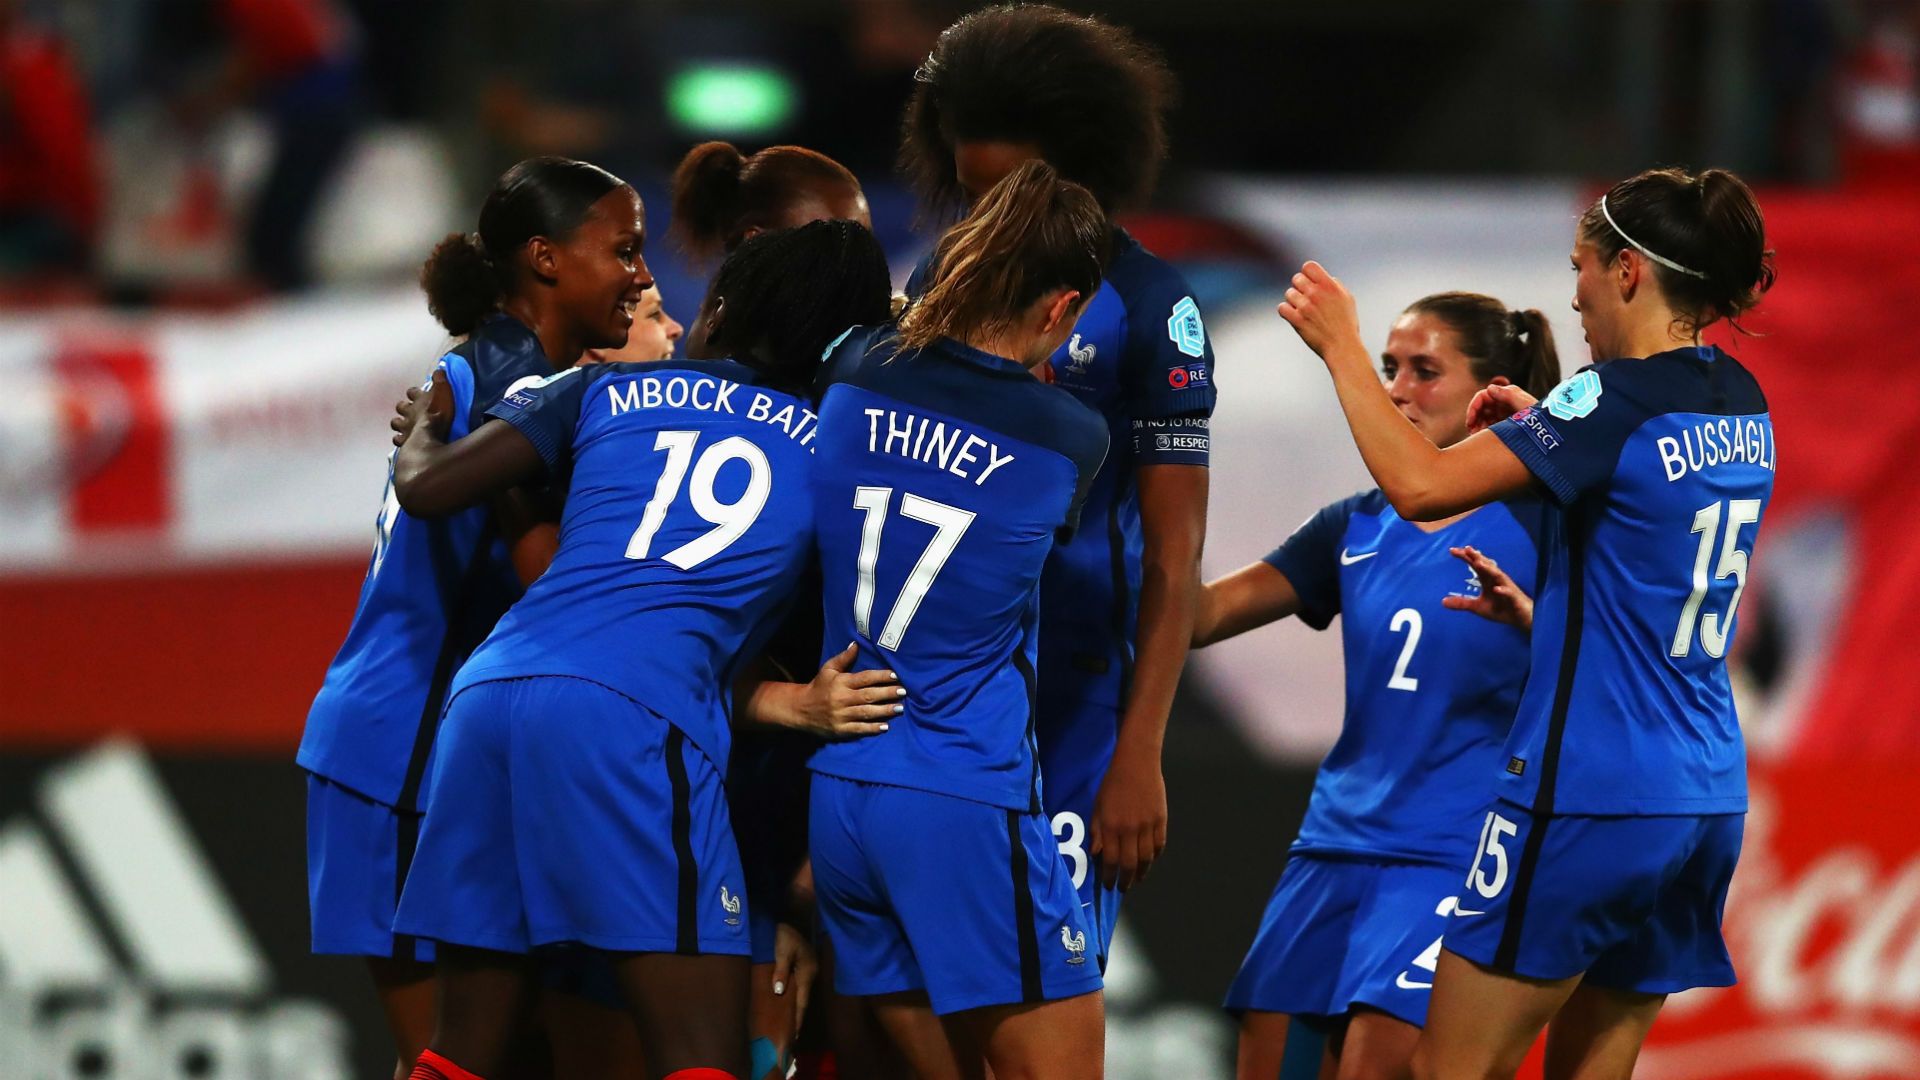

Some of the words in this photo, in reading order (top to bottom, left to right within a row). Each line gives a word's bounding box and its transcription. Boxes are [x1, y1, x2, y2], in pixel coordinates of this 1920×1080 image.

[608, 377, 740, 416] MBOCK
[864, 408, 1015, 486] THINEY
[1657, 417, 1776, 483] BUSSAGLI
[624, 430, 771, 571] 19
[853, 486, 977, 652] 17
[1670, 499, 1761, 659] 15
[1387, 608, 1423, 692] 2
